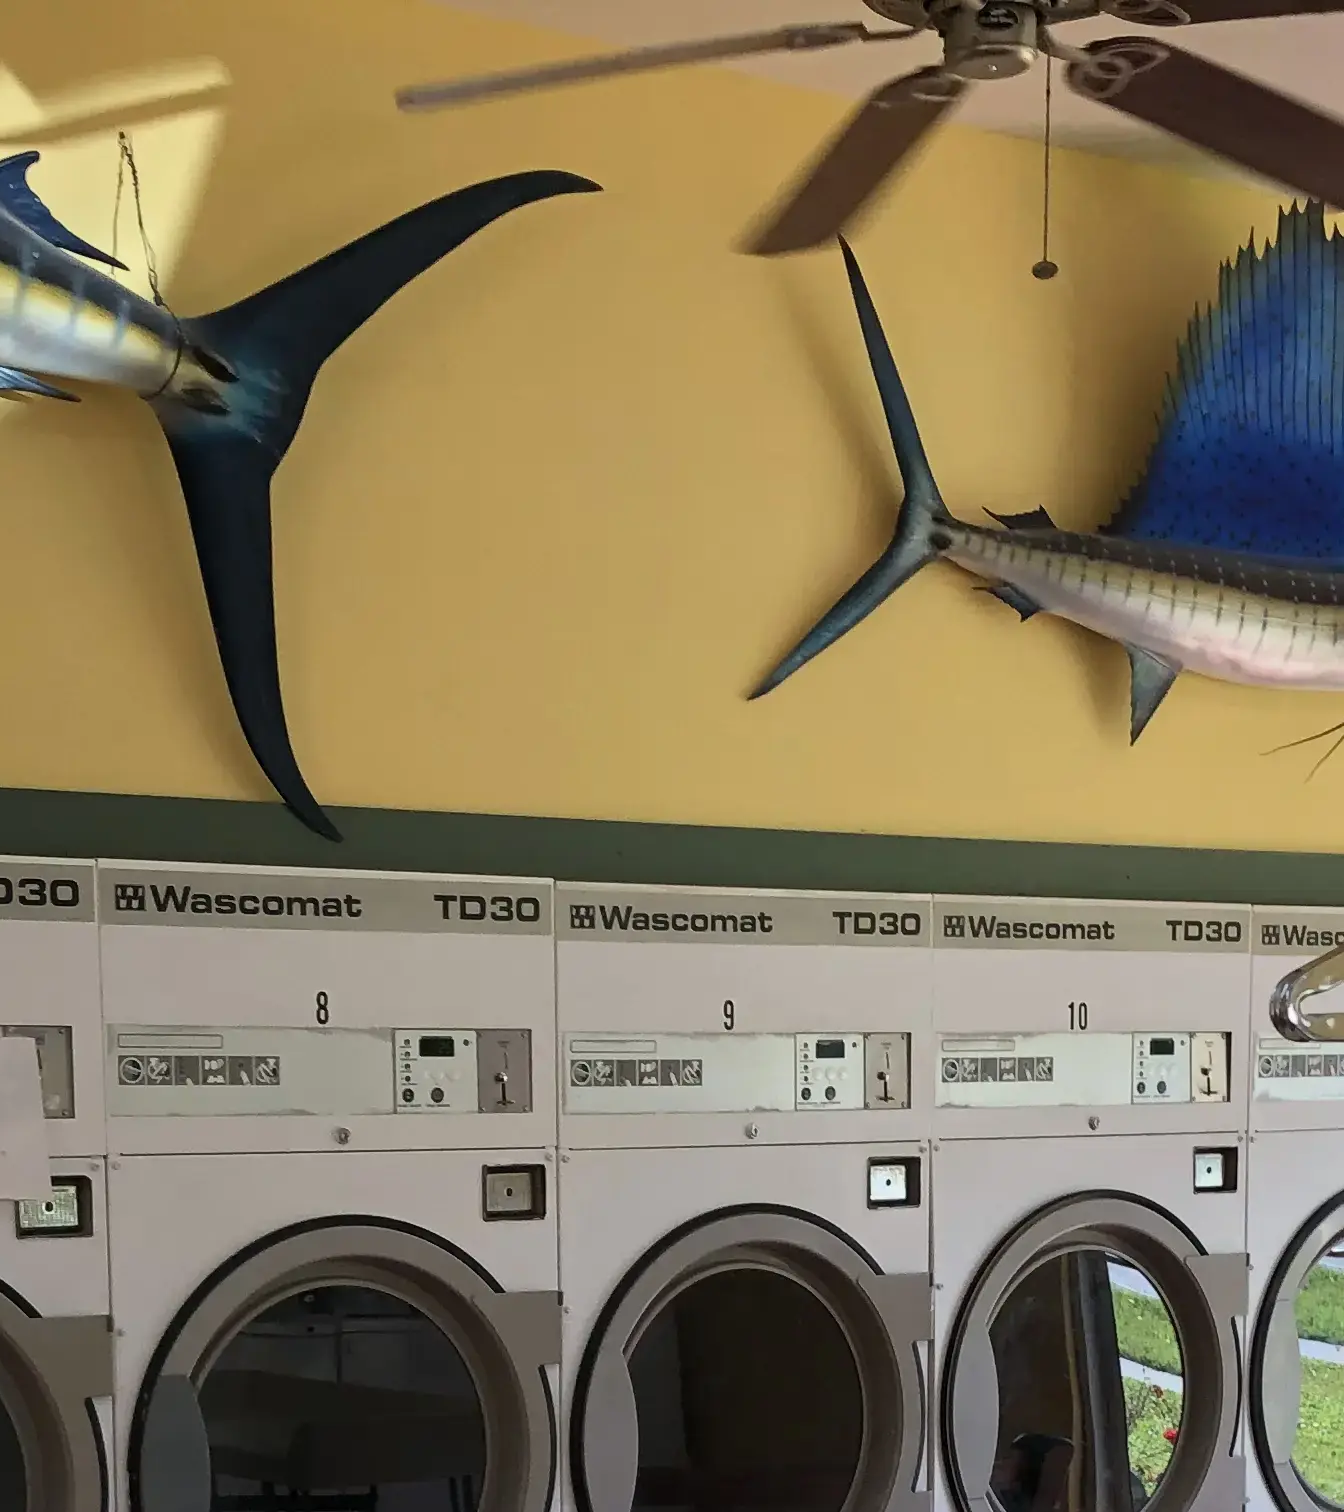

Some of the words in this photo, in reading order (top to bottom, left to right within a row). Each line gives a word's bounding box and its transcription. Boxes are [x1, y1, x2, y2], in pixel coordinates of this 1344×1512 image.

[150, 885, 363, 918] Wascomat
[433, 894, 540, 922] TD30
[599, 904, 773, 932] Wascomat
[832, 911, 921, 936] TD30
[967, 915, 1115, 940] Wascomat
[1165, 919, 1242, 943] TD30
[316, 991, 330, 1025] 8
[723, 999, 735, 1031] 9
[1067, 1001, 1088, 1031] 10
